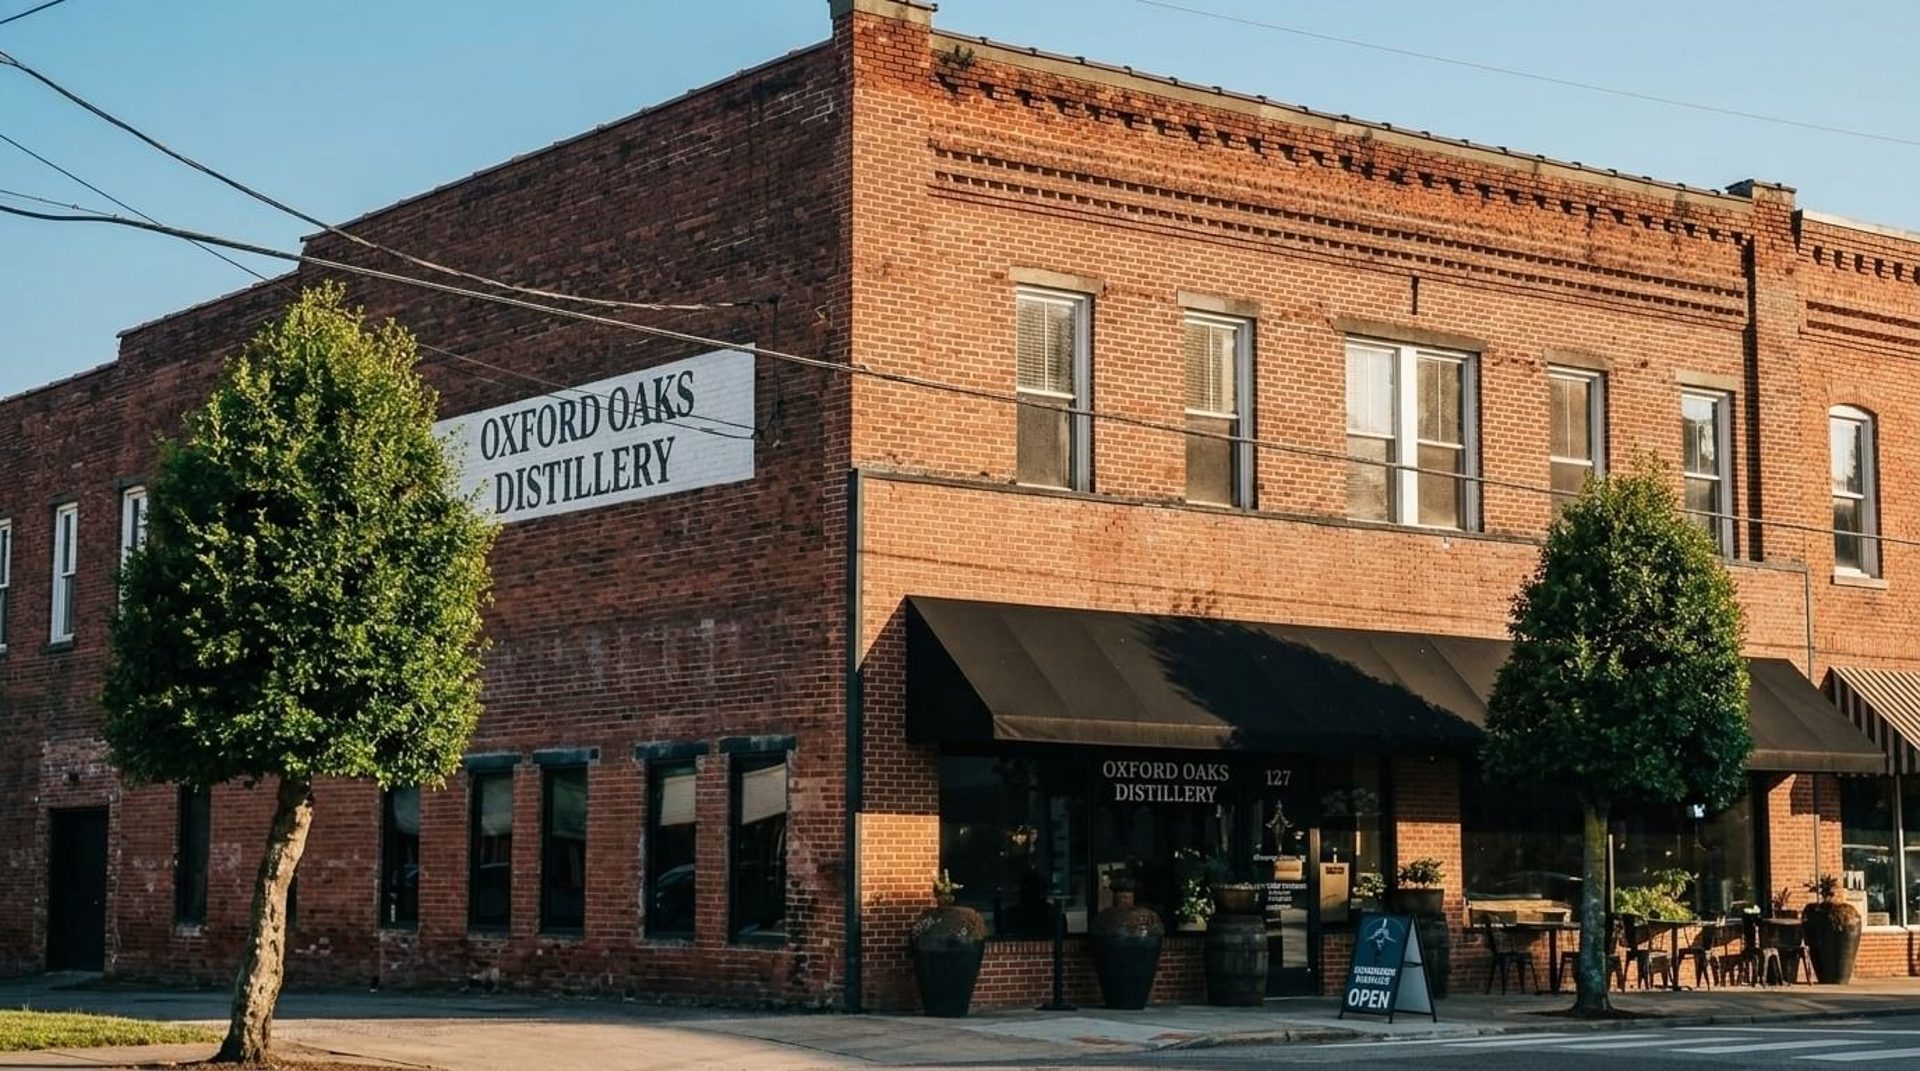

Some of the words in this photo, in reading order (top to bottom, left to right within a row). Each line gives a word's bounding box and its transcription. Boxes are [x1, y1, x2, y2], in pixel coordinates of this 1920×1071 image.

[480, 393, 600, 461] OXFORD
[607, 369, 695, 433] OAKS
[494, 436, 676, 515] DISTILLERY
[1103, 760, 1178, 779] OXFORD
[1183, 763, 1229, 782] OAKS
[1266, 769, 1292, 786] 127
[1115, 783, 1217, 803] DISTILLERY
[1348, 988, 1391, 1009] OPEN
